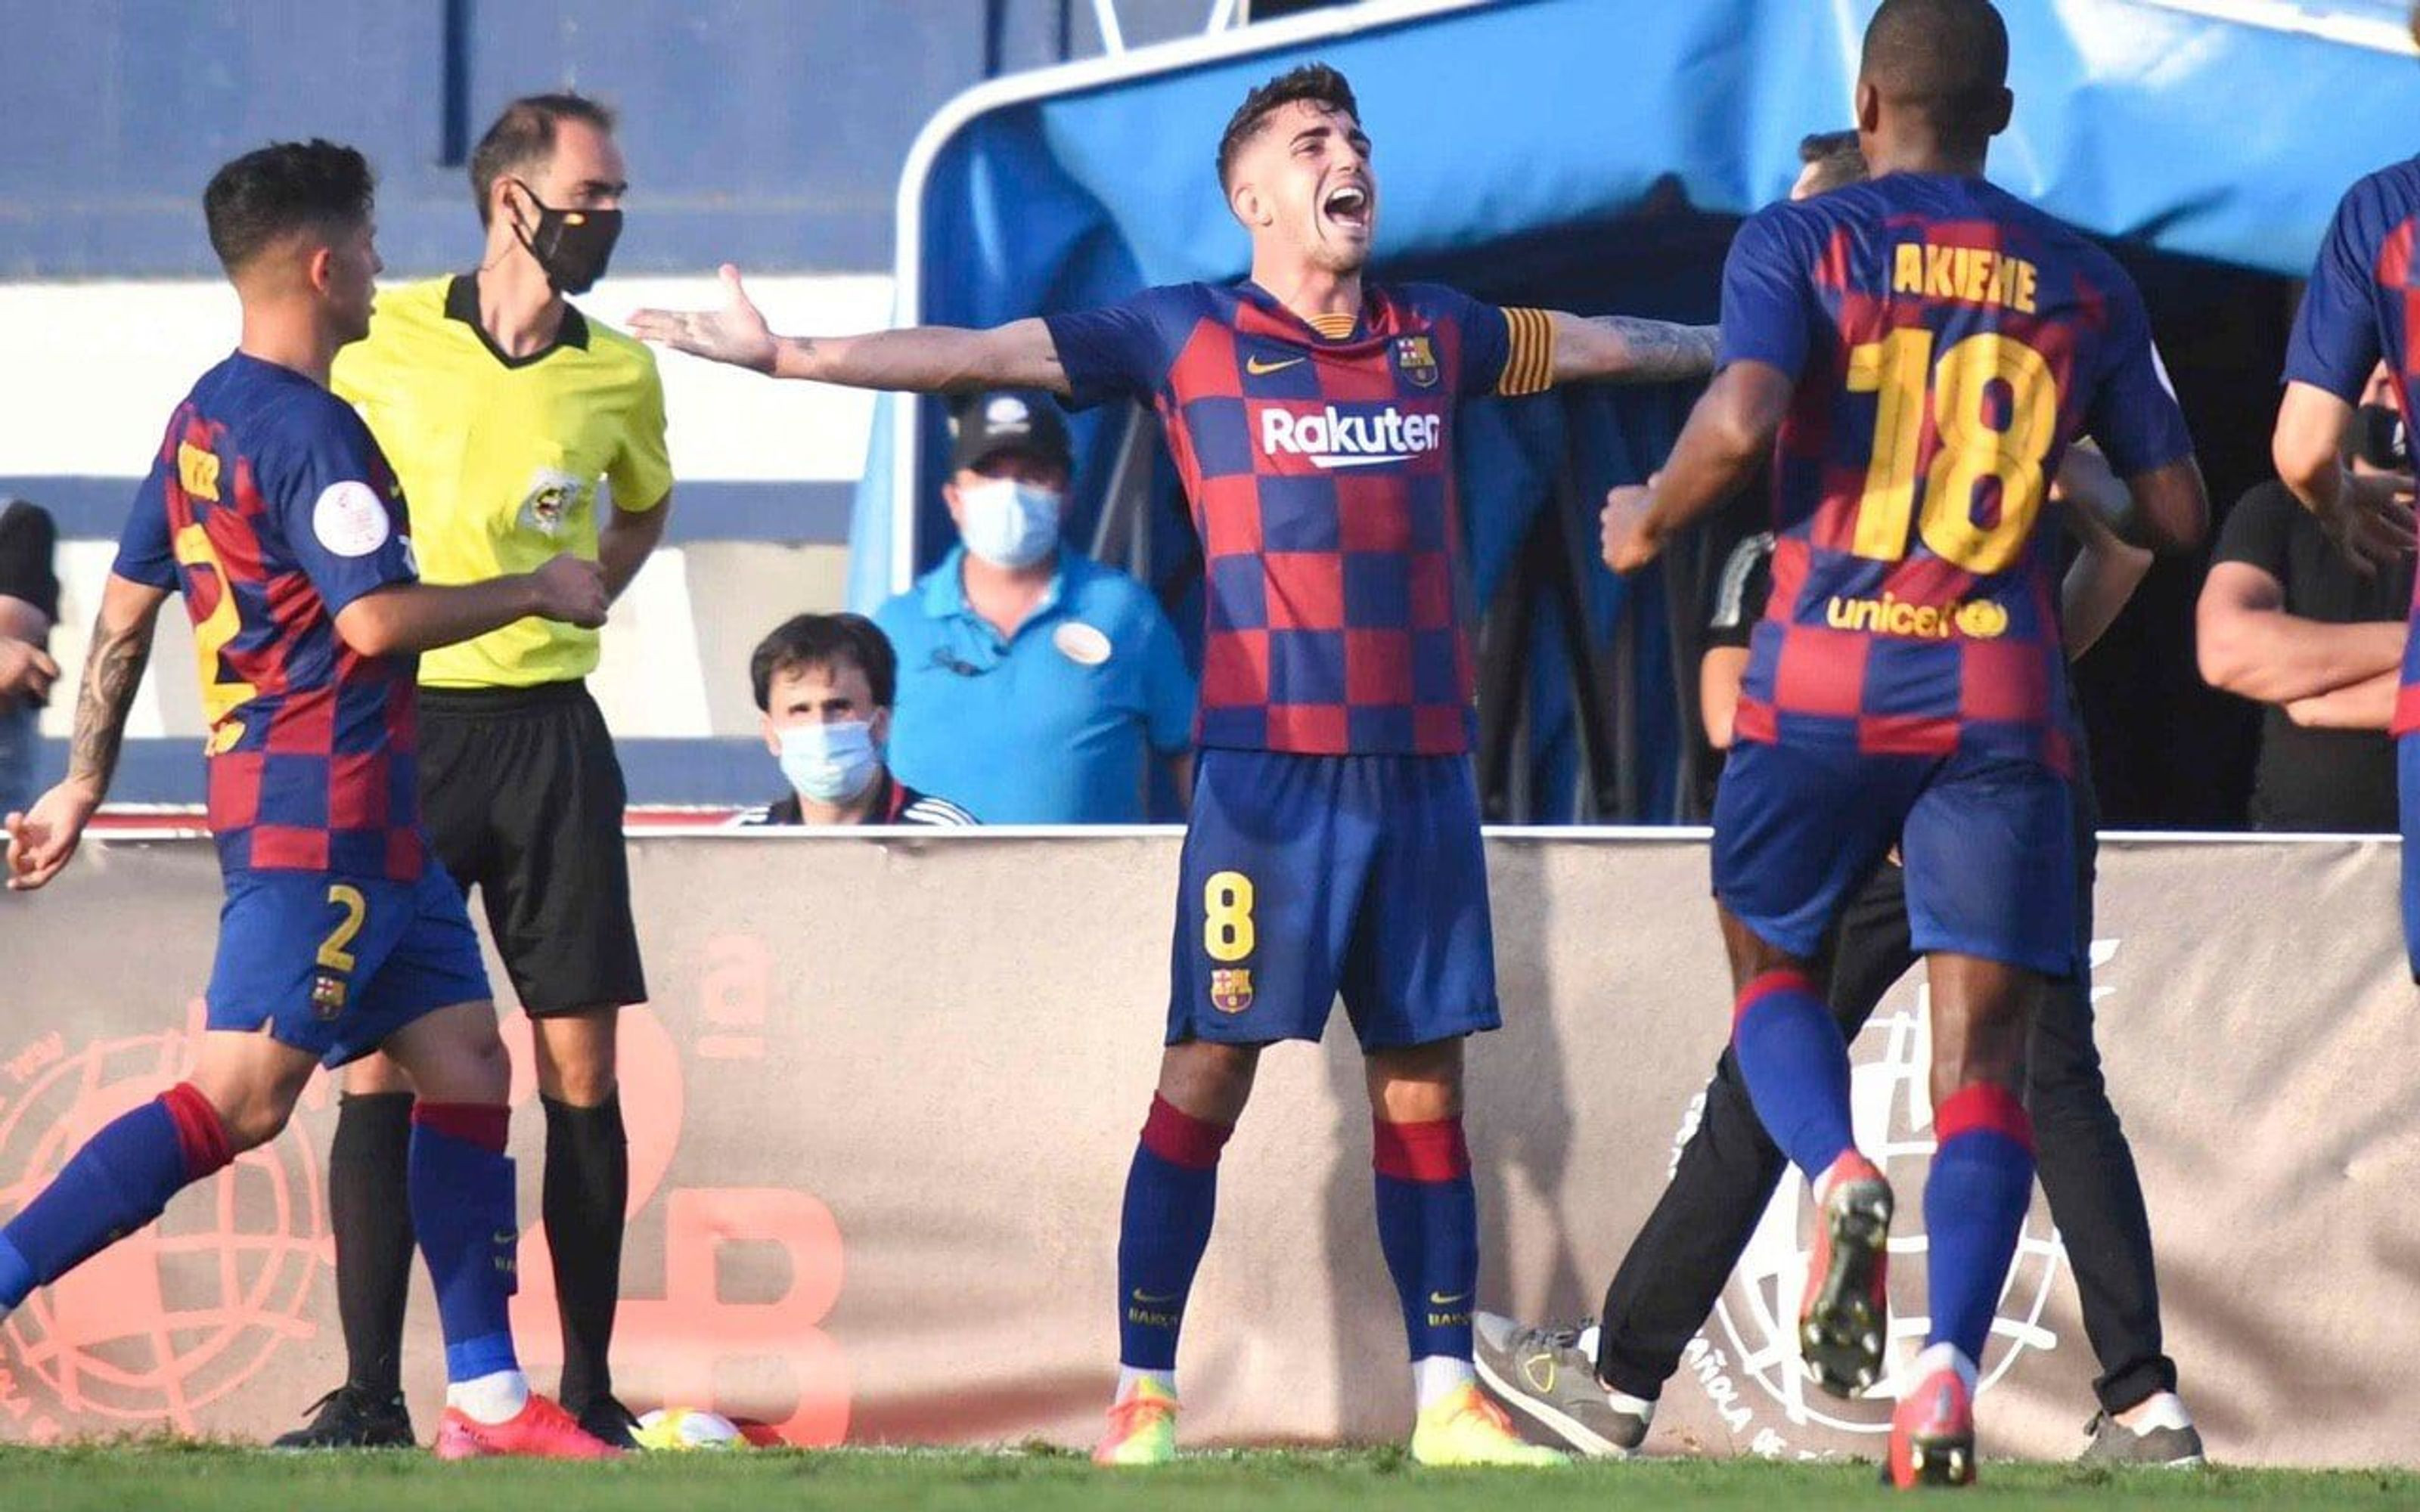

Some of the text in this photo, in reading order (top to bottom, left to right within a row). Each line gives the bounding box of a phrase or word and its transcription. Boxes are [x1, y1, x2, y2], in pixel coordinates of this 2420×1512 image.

[1261, 406, 1440, 454] Rakuten
[1847, 327, 2056, 574] 18
[175, 522, 259, 727] 2
[316, 884, 366, 971] 2
[1204, 870, 1255, 961] 8
